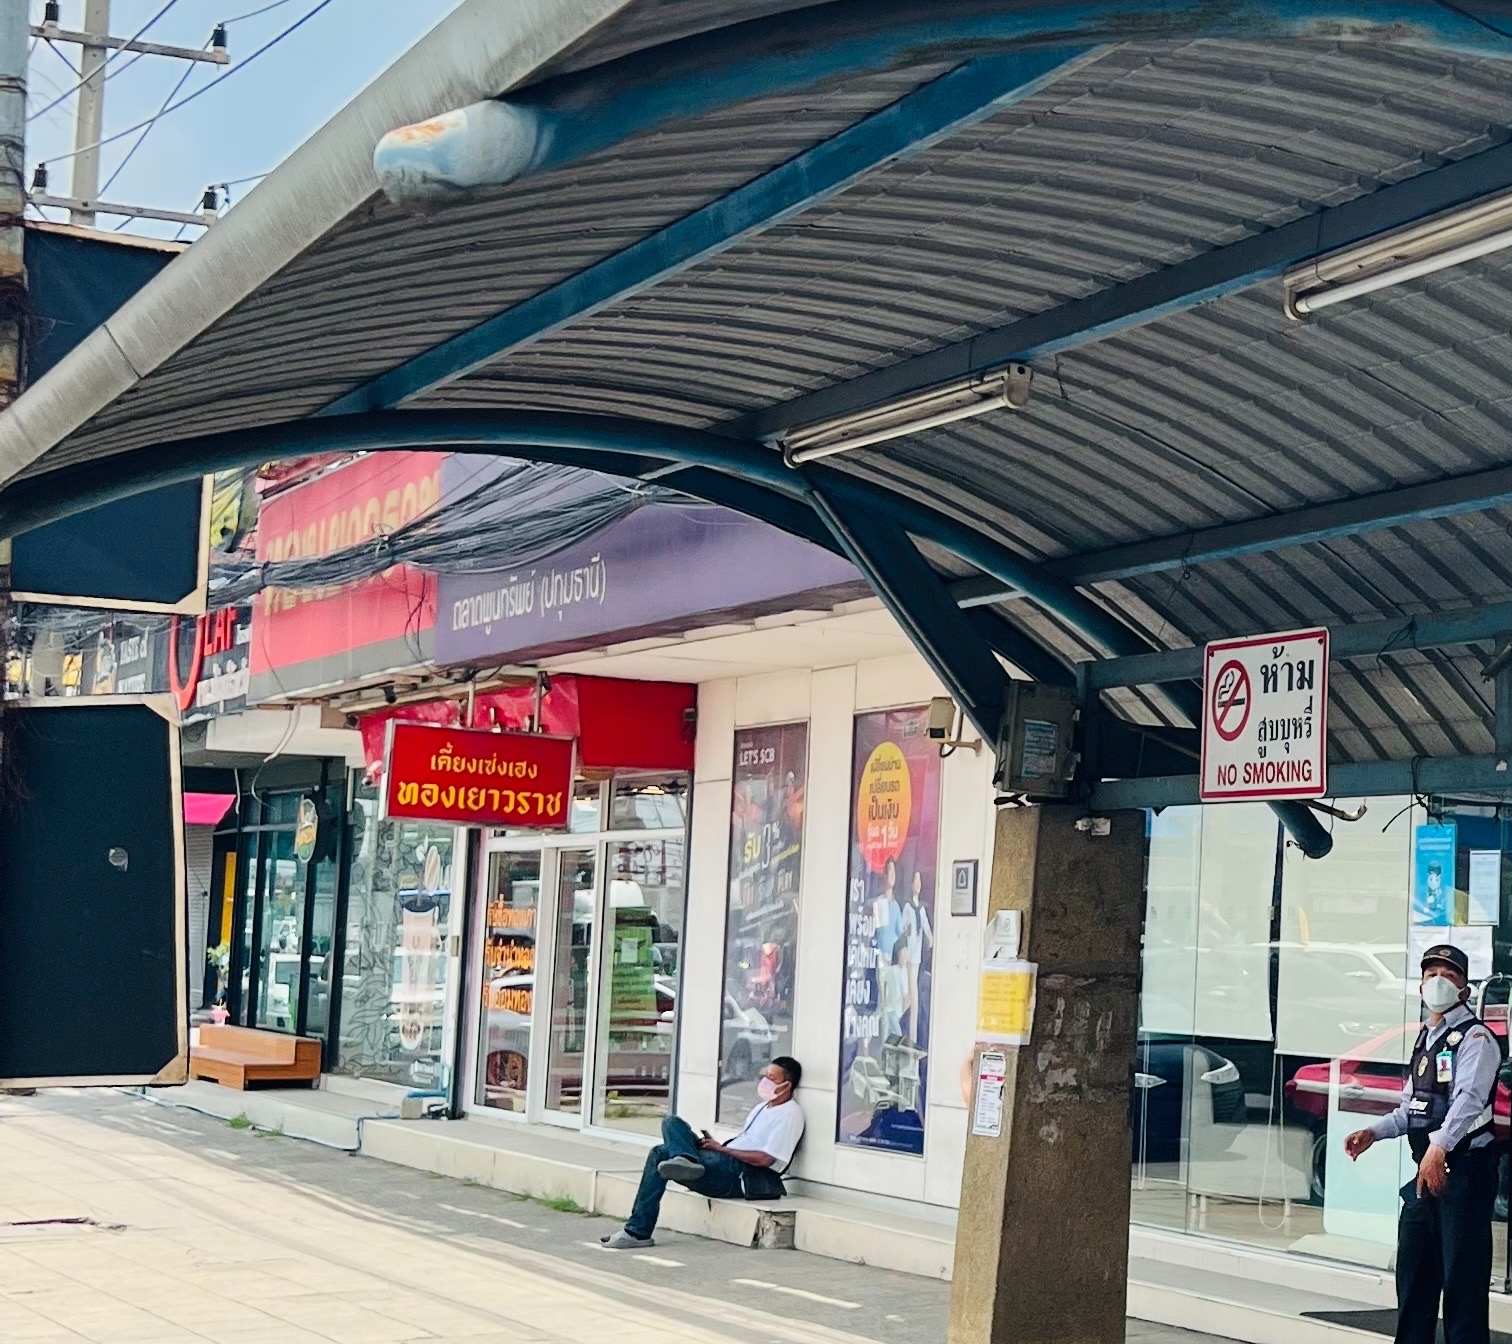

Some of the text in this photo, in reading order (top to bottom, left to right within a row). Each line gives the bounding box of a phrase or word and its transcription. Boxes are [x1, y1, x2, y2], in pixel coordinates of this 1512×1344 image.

[452, 552, 607, 636] ตลาดพูนทรัพย์ (ปทุมธานี)
[1260, 645, 1315, 694] ห้าม
[1257, 695, 1313, 759] สูบบุหรี่
[1217, 759, 1313, 786] NO SMOKING
[397, 780, 563, 817] ทองเยาวราช
